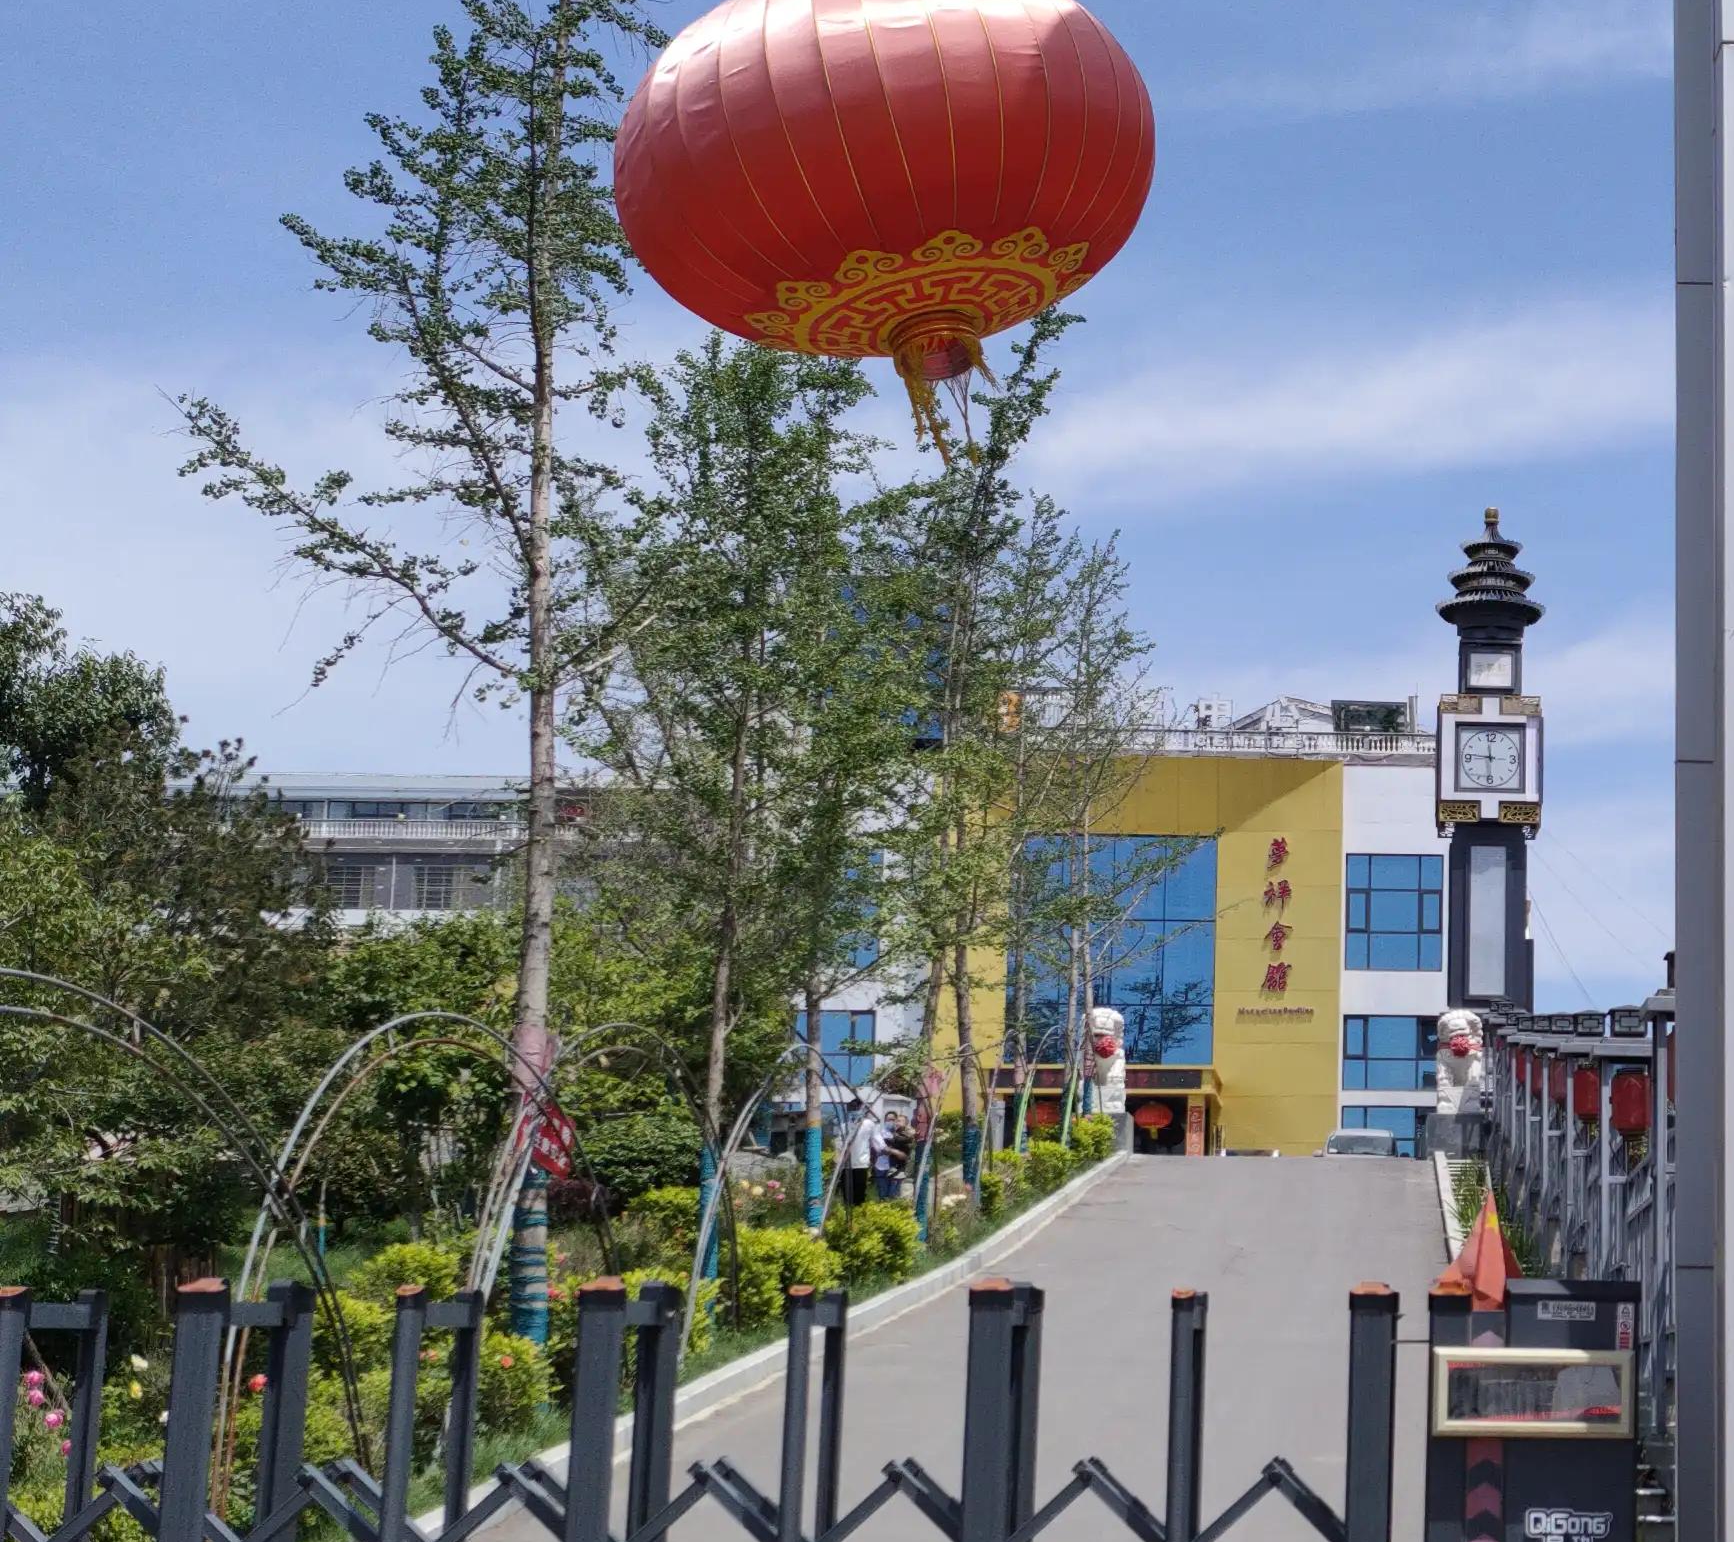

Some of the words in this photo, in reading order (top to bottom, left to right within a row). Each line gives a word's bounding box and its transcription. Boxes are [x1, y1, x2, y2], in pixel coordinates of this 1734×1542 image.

[1486, 733, 1497, 743] 12
[1464, 753, 1472, 763] 9
[1509, 755, 1517, 765] 3
[1486, 775, 1494, 785] 6
